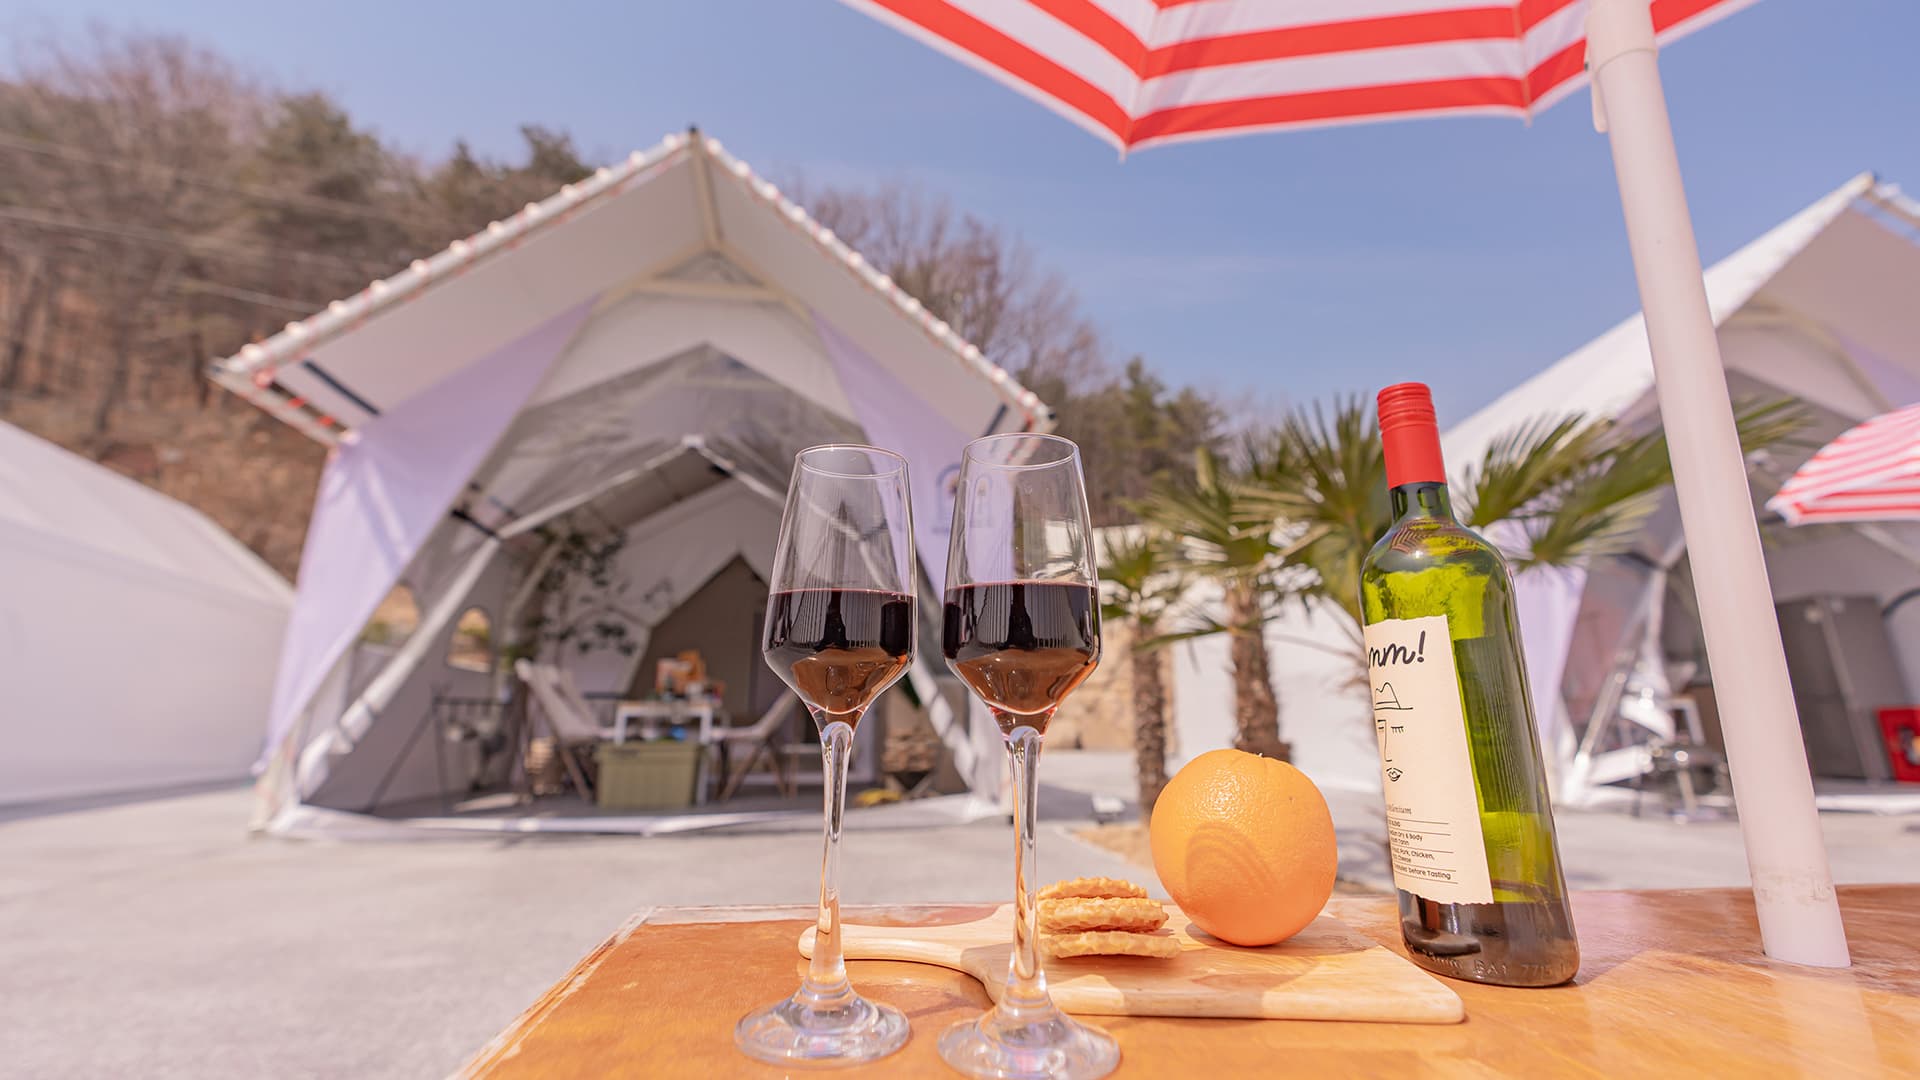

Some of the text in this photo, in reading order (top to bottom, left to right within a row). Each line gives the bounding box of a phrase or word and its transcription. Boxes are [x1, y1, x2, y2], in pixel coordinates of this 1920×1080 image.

[1409, 833, 1423, 842] Body
[1410, 850, 1435, 860] Chicken,
[1408, 867, 1427, 876] before
[1427, 870, 1452, 880] Tasting
